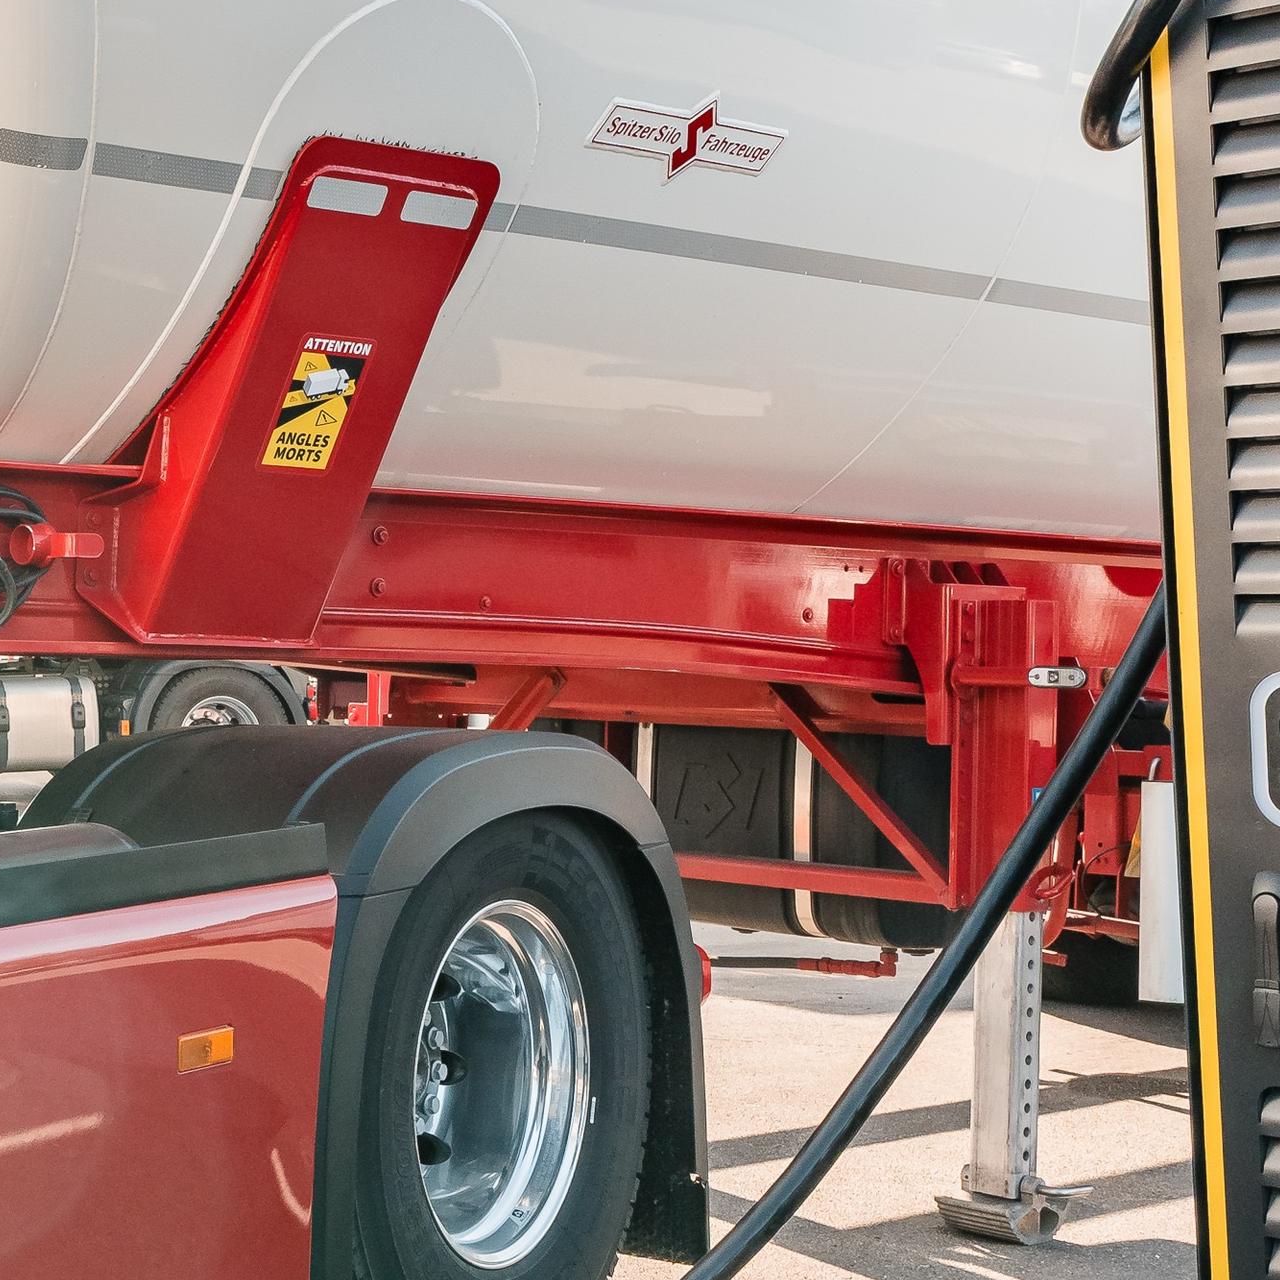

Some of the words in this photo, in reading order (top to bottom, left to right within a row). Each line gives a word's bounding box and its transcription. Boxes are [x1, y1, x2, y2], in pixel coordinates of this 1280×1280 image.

[701, 134, 770, 162] Fahrzeuge
[304, 338, 372, 355] ATTENTION
[276, 431, 331, 447] ANGLES
[273, 447, 322, 462] MORTS
